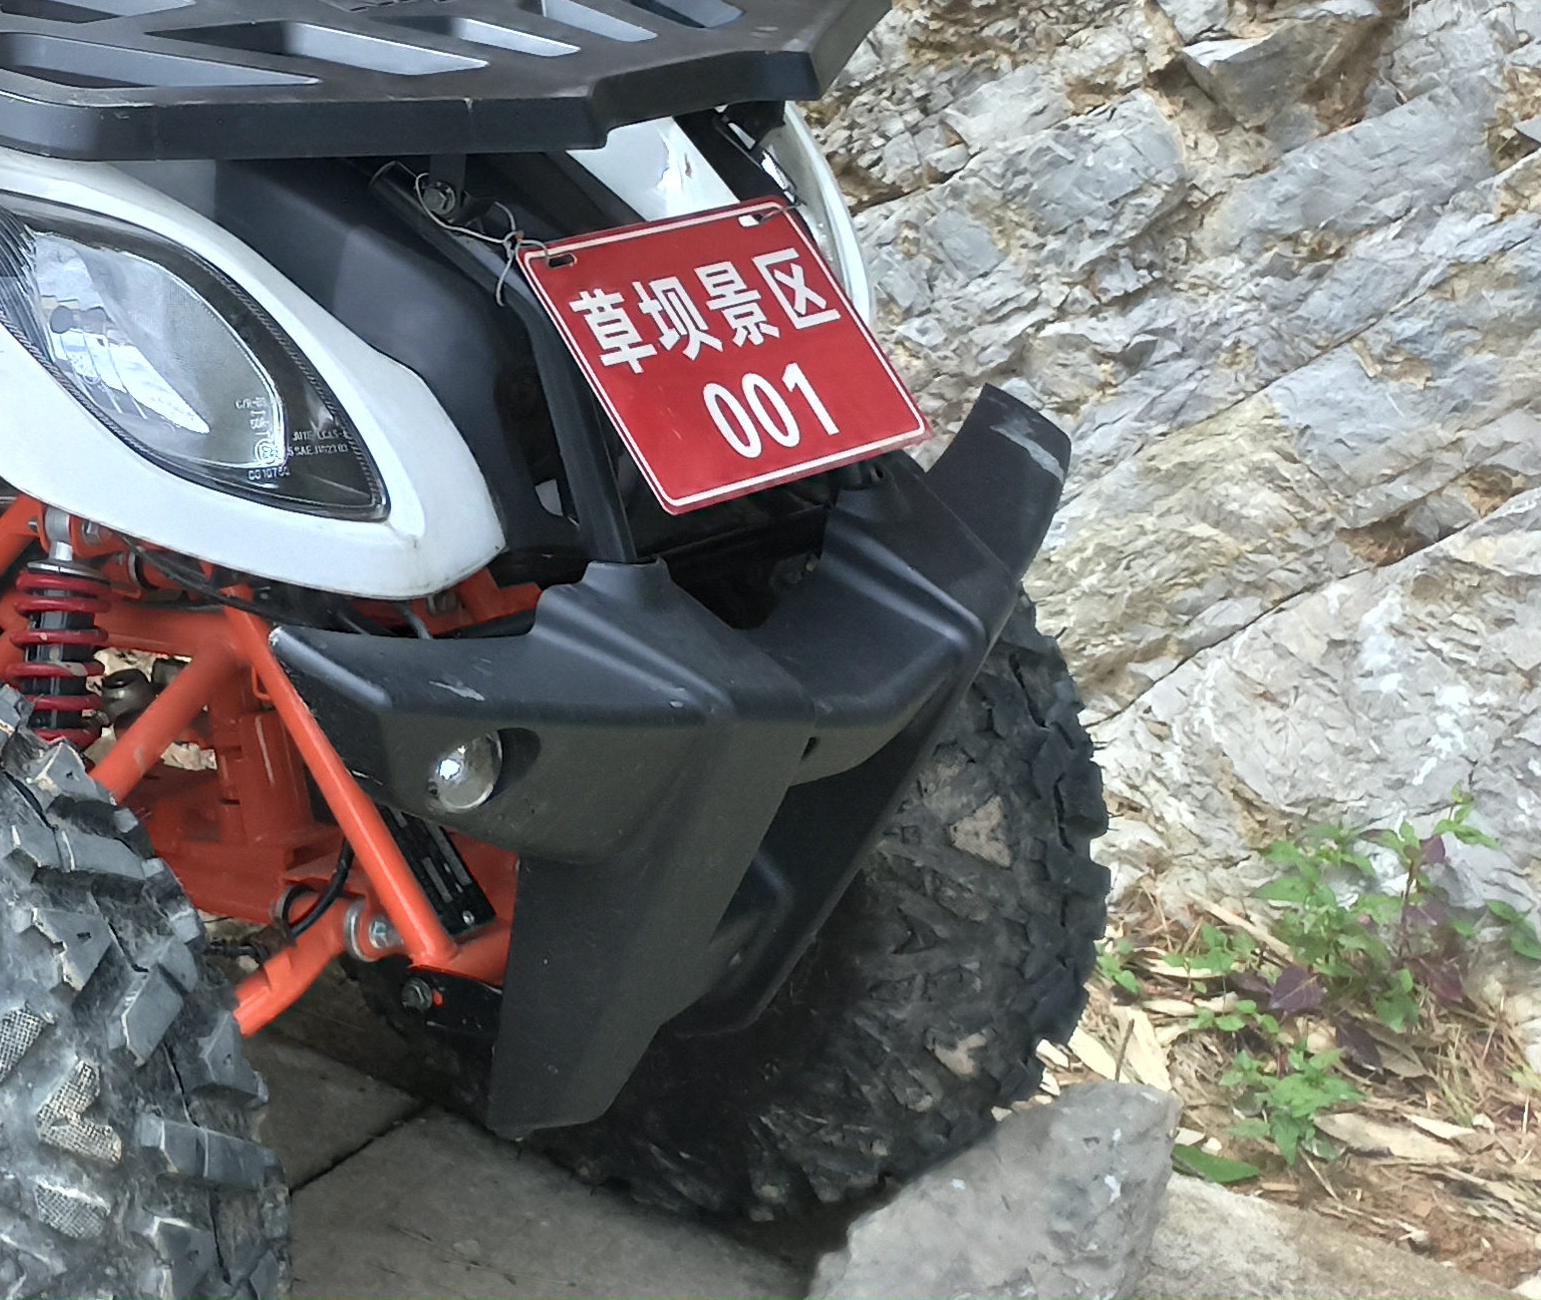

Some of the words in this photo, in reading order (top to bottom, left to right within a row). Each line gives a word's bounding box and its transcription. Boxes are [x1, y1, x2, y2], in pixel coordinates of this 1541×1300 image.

[569, 247, 841, 373] 草坝景区
[703, 362, 840, 459] 001
